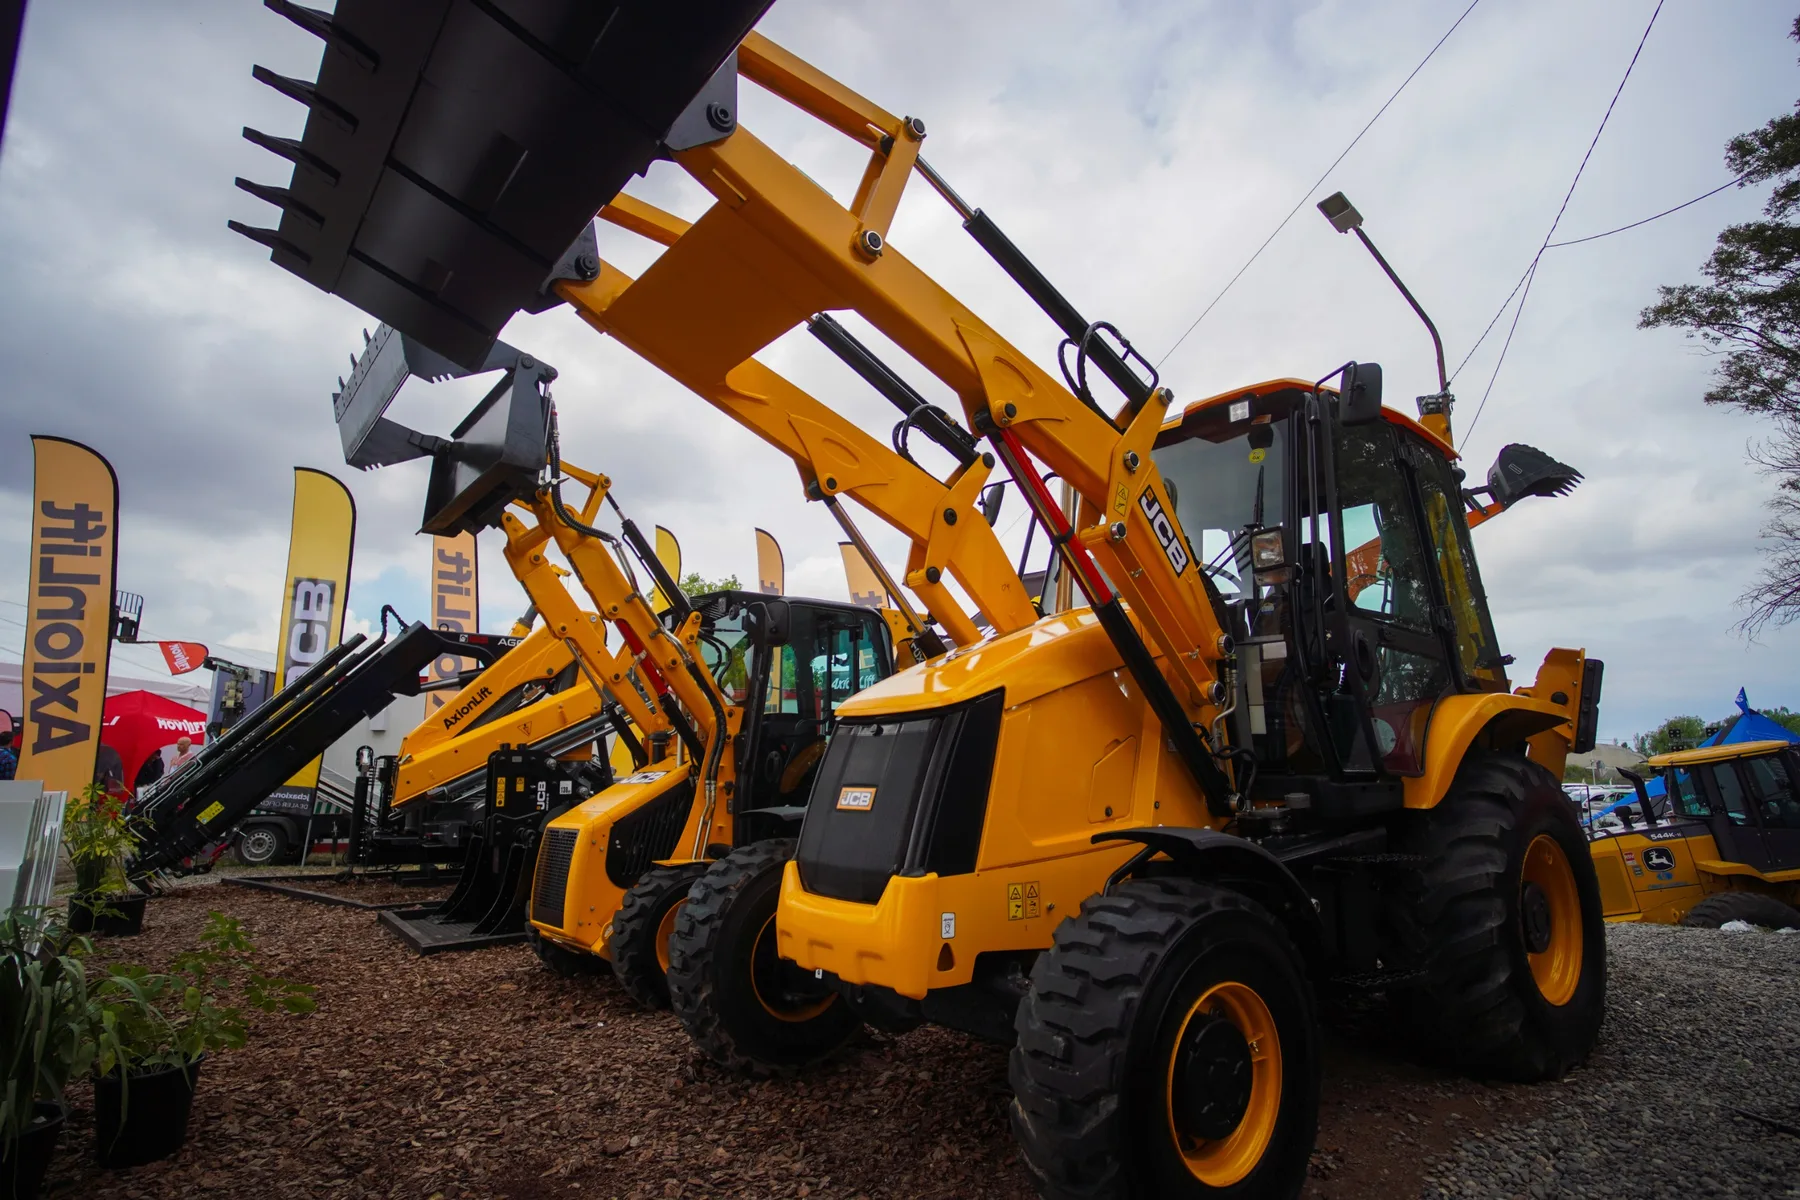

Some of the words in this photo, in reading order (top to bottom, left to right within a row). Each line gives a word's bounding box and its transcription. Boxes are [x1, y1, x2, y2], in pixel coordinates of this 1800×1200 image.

[1140, 493, 1188, 574] JCB
[443, 686, 493, 731] AxionLift
[620, 772, 668, 784] JCB
[537, 781, 547, 810] JCB
[841, 792, 872, 806] JCB
